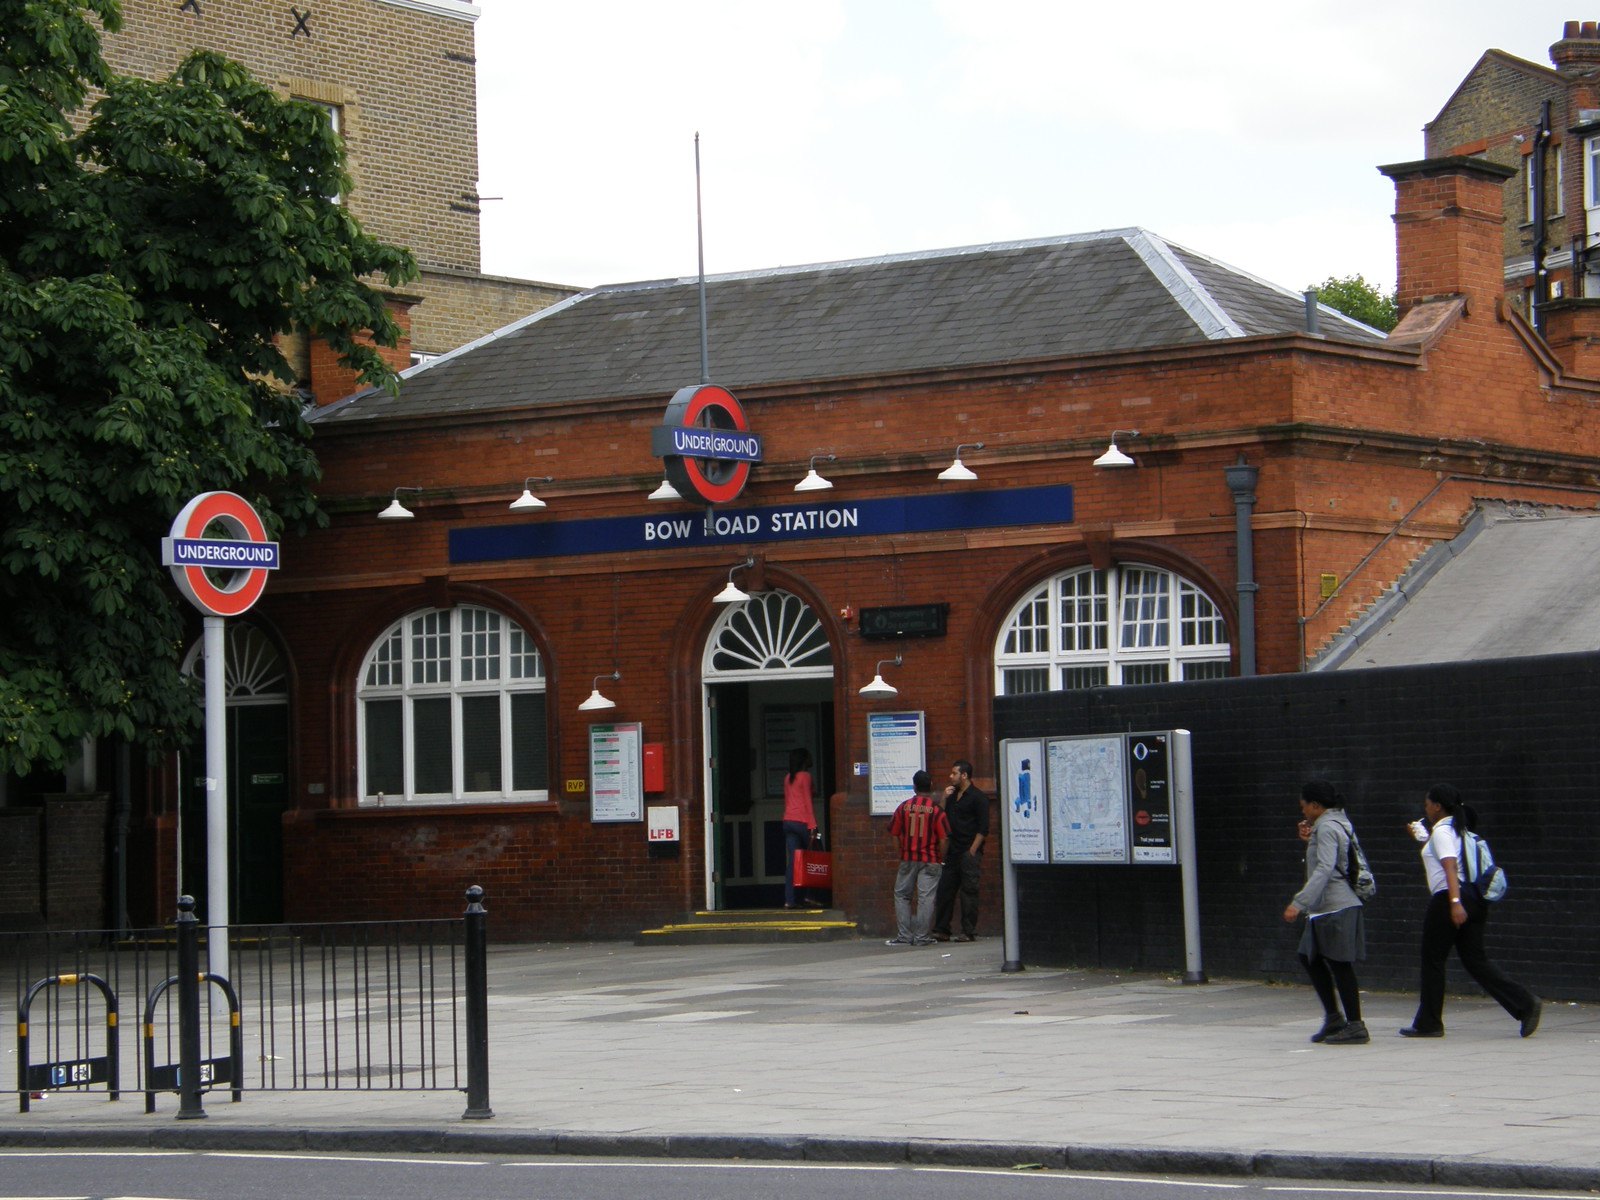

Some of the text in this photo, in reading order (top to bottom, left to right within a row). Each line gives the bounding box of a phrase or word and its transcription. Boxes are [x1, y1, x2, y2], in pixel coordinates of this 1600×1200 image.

[675, 431, 758, 457] UNDERGROUND
[644, 520, 692, 541] BOW
[771, 508, 858, 532] STATION
[177, 544, 274, 562] UNDERGROUND
[567, 780, 585, 791] RVP
[650, 829, 674, 839] LFB
[909, 813, 925, 837] 11
[806, 863, 829, 873] ESPRIT
